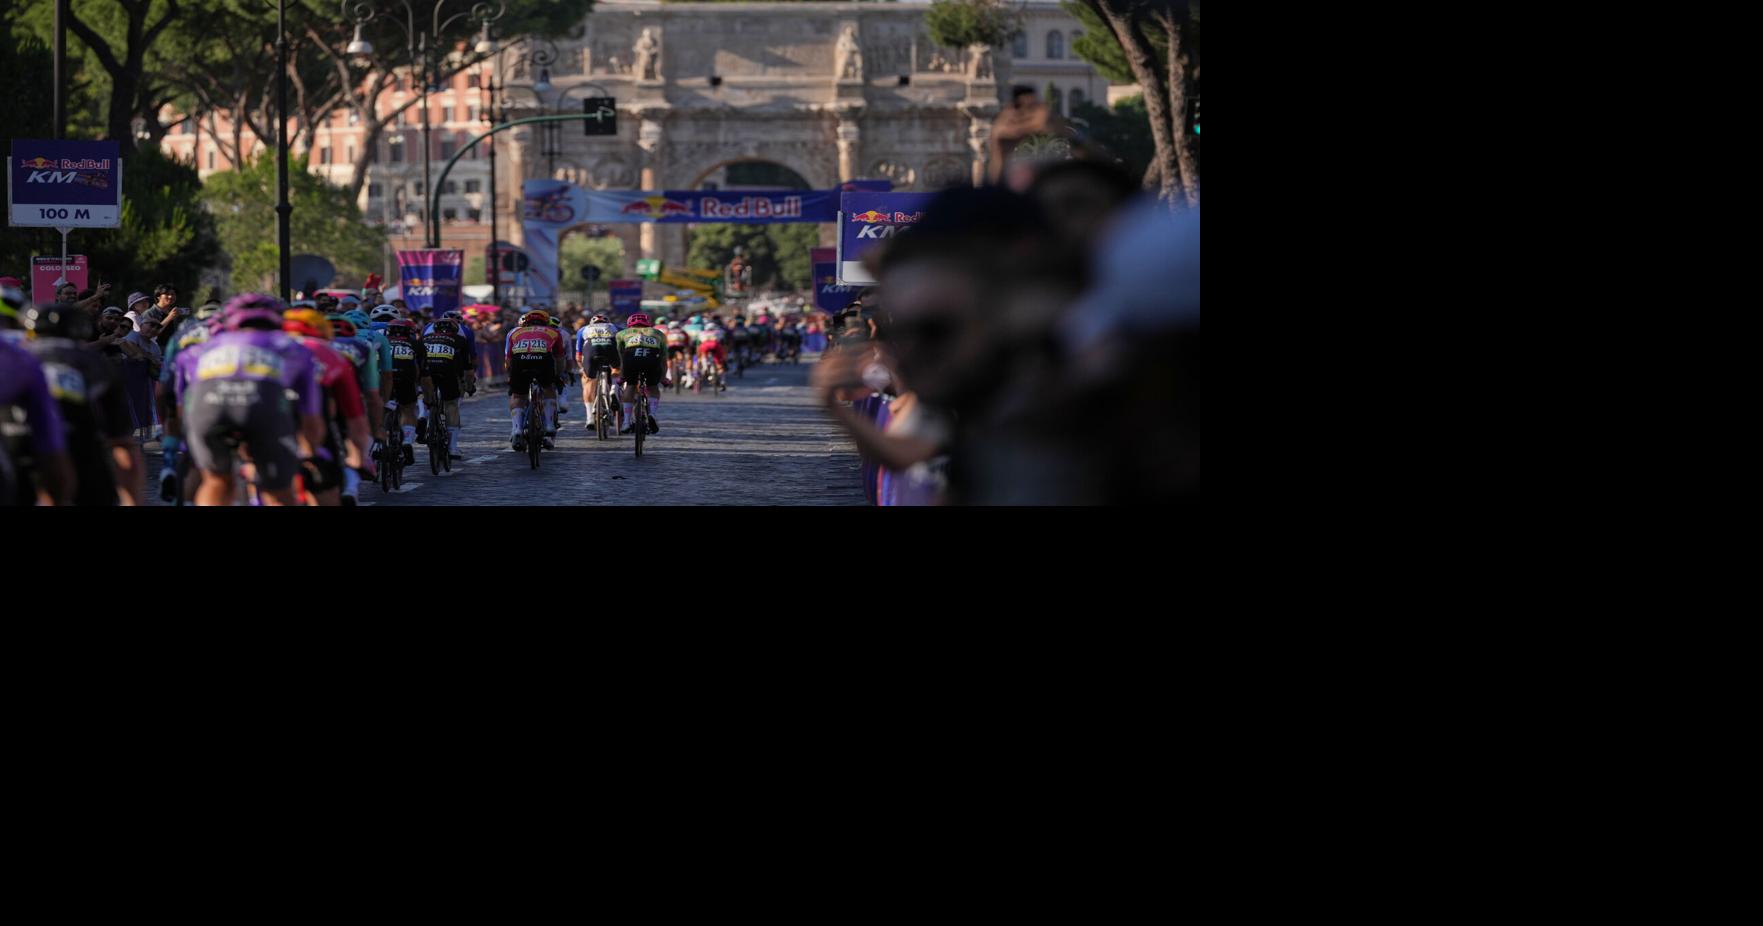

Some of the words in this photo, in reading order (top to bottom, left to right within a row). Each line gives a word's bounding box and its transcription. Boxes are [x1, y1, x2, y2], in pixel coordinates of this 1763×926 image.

[27, 171, 78, 183] KM
[40, 208, 68, 219] 100
[74, 208, 90, 219] M
[634, 348, 649, 357] EF
